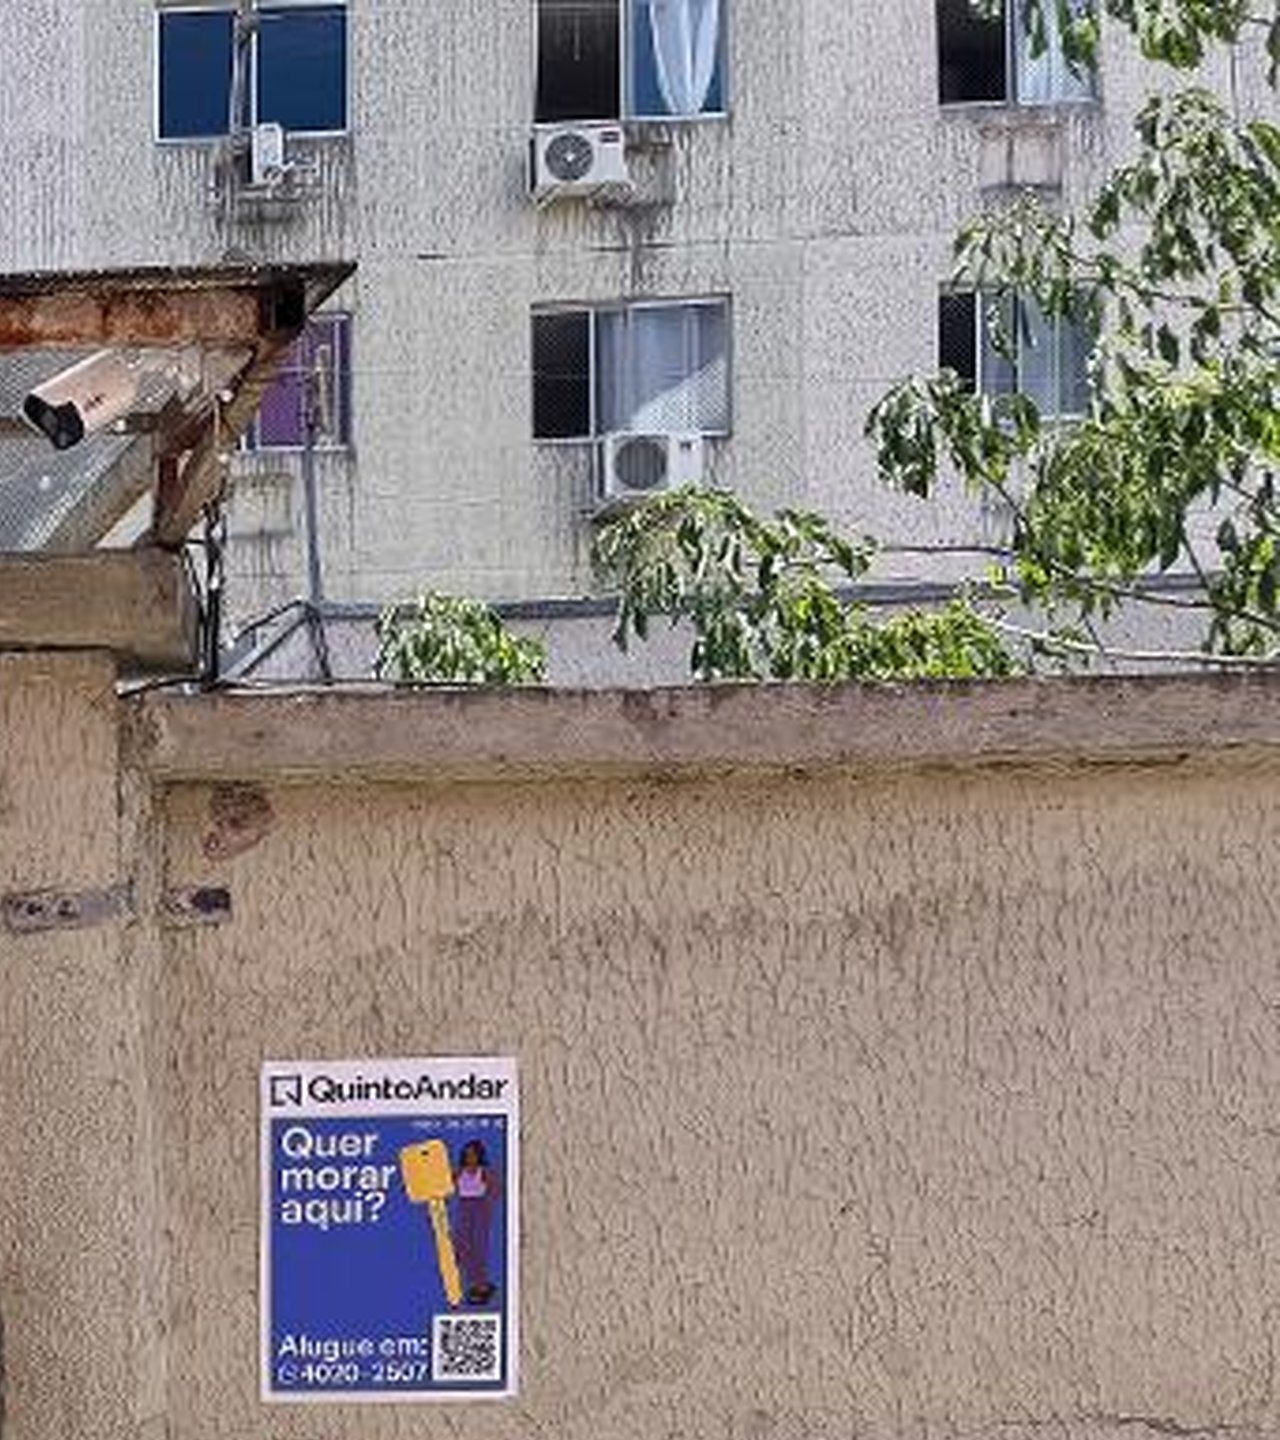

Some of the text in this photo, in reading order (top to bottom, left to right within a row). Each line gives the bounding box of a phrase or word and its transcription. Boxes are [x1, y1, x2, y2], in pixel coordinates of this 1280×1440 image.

[307, 1074, 508, 1103] QuintoAndar
[281, 1127, 378, 1157] Quer
[281, 1165, 396, 1190] morar
[281, 1192, 385, 1230] aqui?
[278, 1335, 428, 1362] Alugue em:
